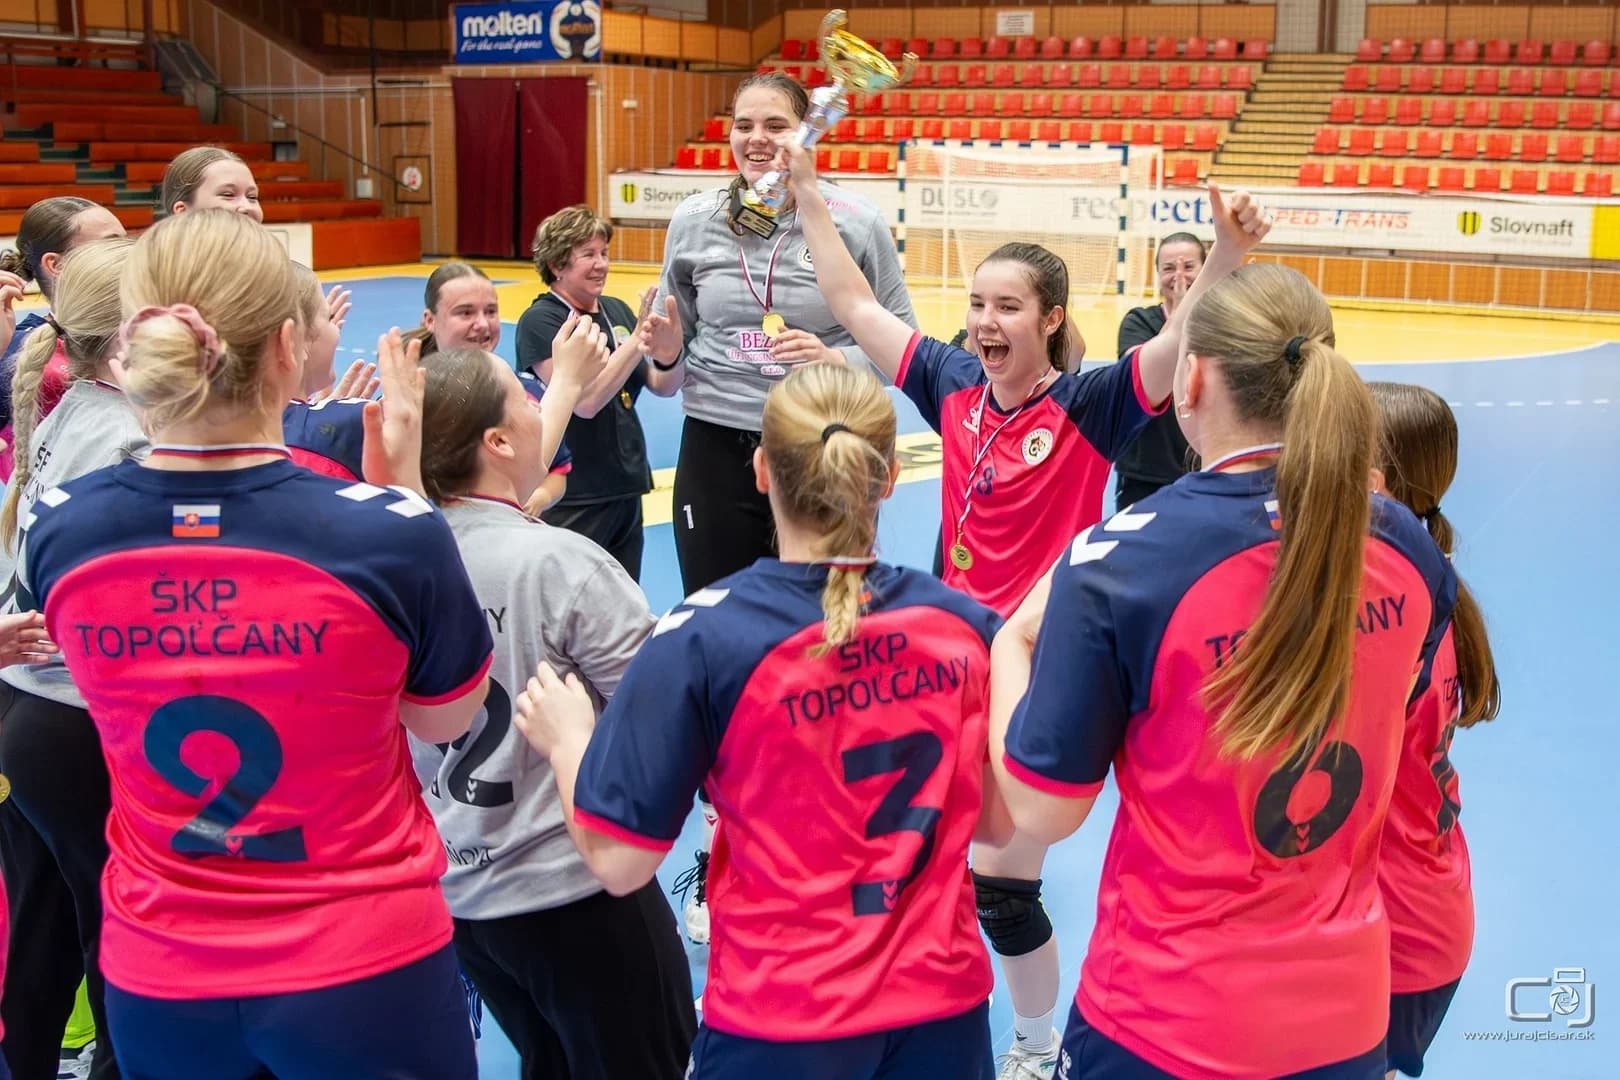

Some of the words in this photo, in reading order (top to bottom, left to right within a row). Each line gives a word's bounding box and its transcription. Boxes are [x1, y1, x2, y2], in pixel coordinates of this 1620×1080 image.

[462, 11, 543, 38] molten
[1490, 216, 1574, 237] Slovnaft
[976, 466, 994, 496] 8
[683, 504, 694, 529] 1
[151, 569, 238, 614] ŠKP
[75, 614, 329, 659] TOPOĽČANY
[779, 655, 969, 727] TOPOĽČANY
[143, 693, 309, 863] 2
[1254, 722, 1364, 860] 6
[841, 729, 944, 917] 3
